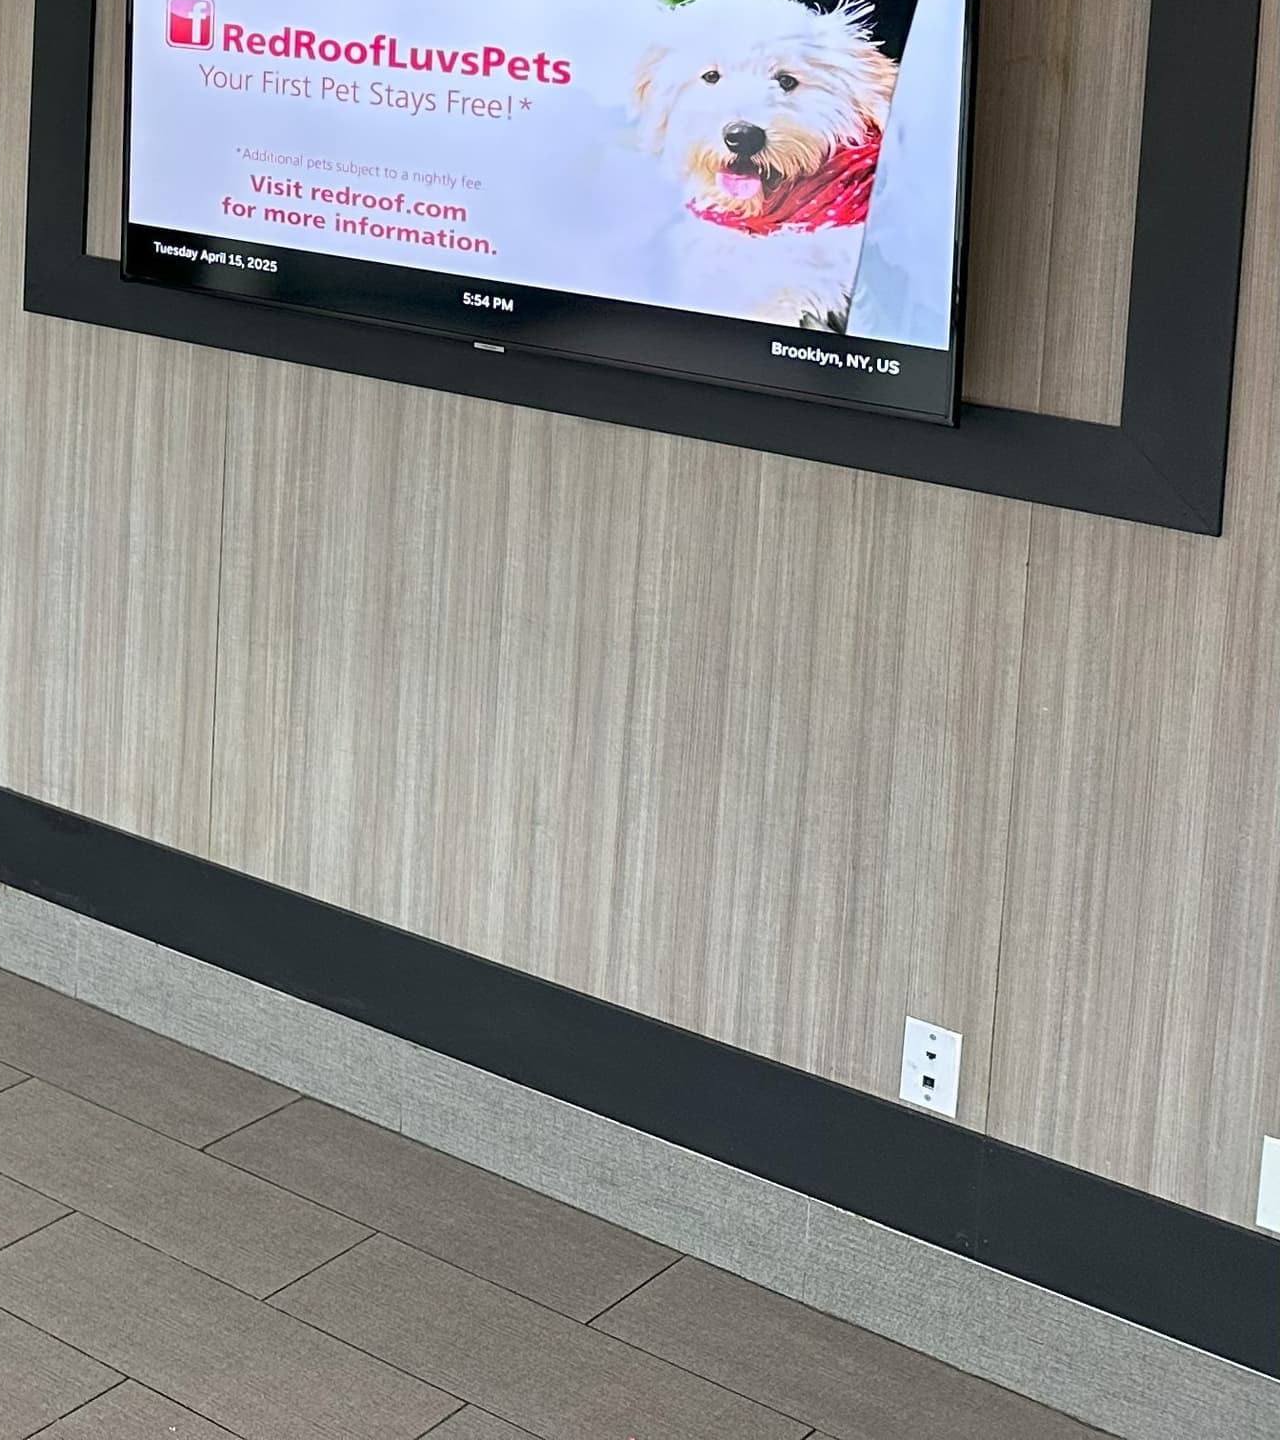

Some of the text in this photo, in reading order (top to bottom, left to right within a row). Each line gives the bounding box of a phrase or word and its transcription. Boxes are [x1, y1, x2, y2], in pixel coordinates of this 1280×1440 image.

[222, 23, 572, 86] RedRoofLuvsPets
[199, 63, 254, 92] Your
[262, 71, 312, 99] First
[321, 76, 361, 105] Pet
[369, 81, 437, 117] Stays
[306, 157, 334, 172] pets
[335, 160, 380, 179] subject
[384, 167, 398, 180] to
[401, 170, 409, 181] a
[413, 170, 457, 190] nightly
[248, 173, 467, 222] Visit redroof.com
[221, 196, 498, 255] for more information.
[153, 241, 278, 273] Tuesday April 15, 2025
[462, 291, 514, 313] 5:54 PM
[771, 341, 901, 376] Brooklyn, NY, US
